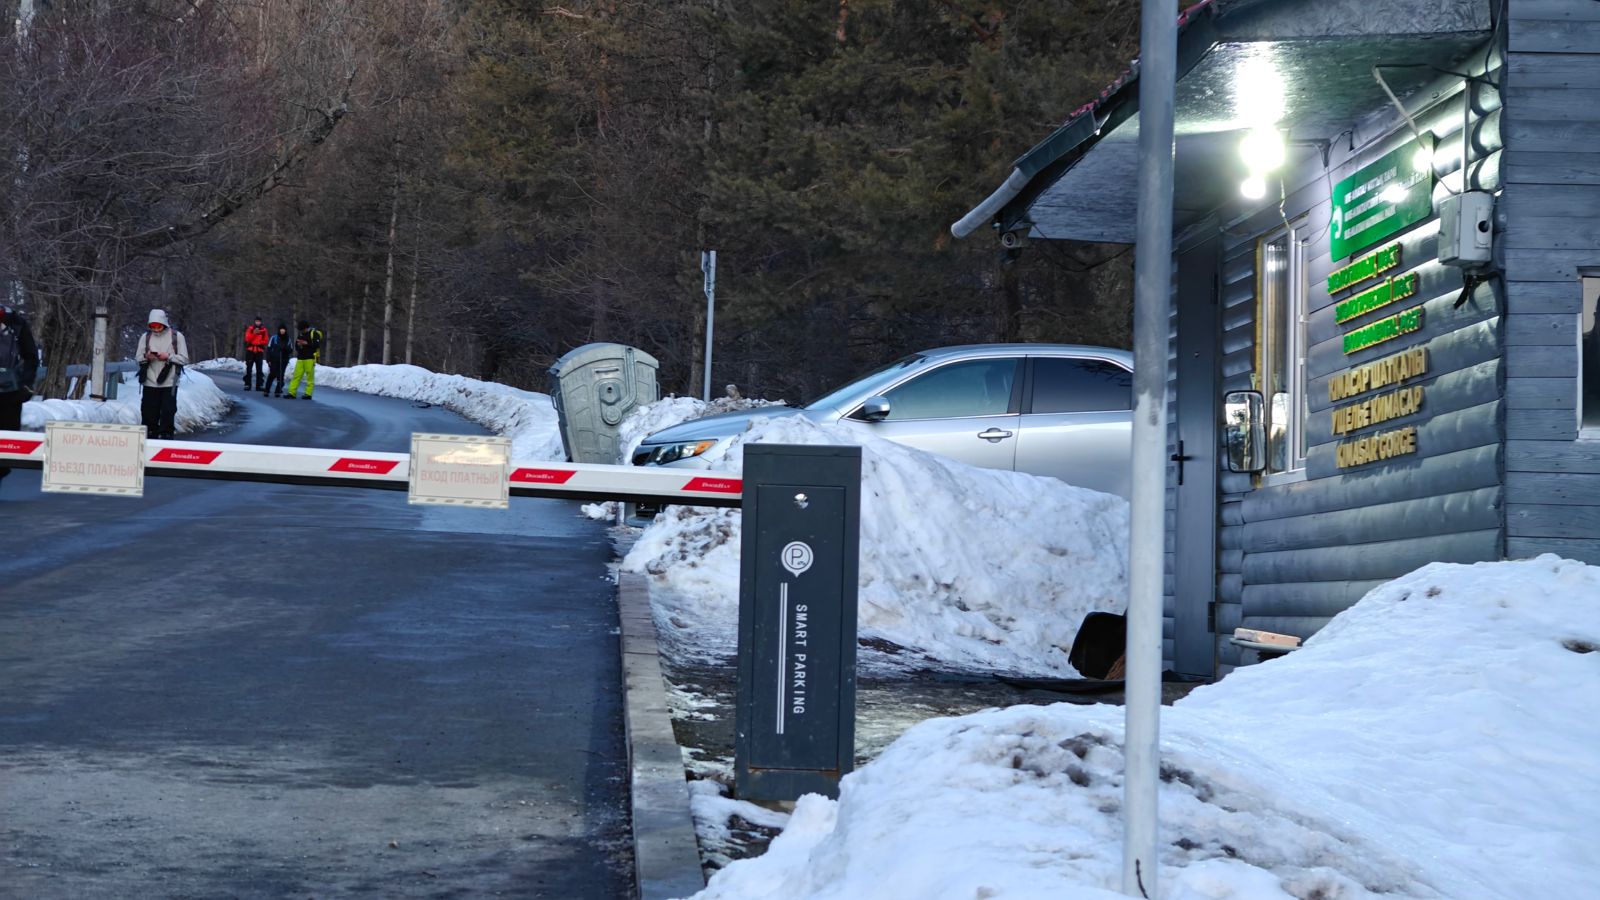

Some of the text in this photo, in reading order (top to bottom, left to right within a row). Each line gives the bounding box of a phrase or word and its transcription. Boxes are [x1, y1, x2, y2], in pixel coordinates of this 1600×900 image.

[63, 433, 129, 449] КІРУ АҚЫЛЫ
[50, 462, 137, 477] ВЪЕЗД ПЛАТНЫЙ
[421, 469, 499, 485] ВХОД ПЛАТНЫЙ
[793, 604, 808, 714] SMART PARKING
